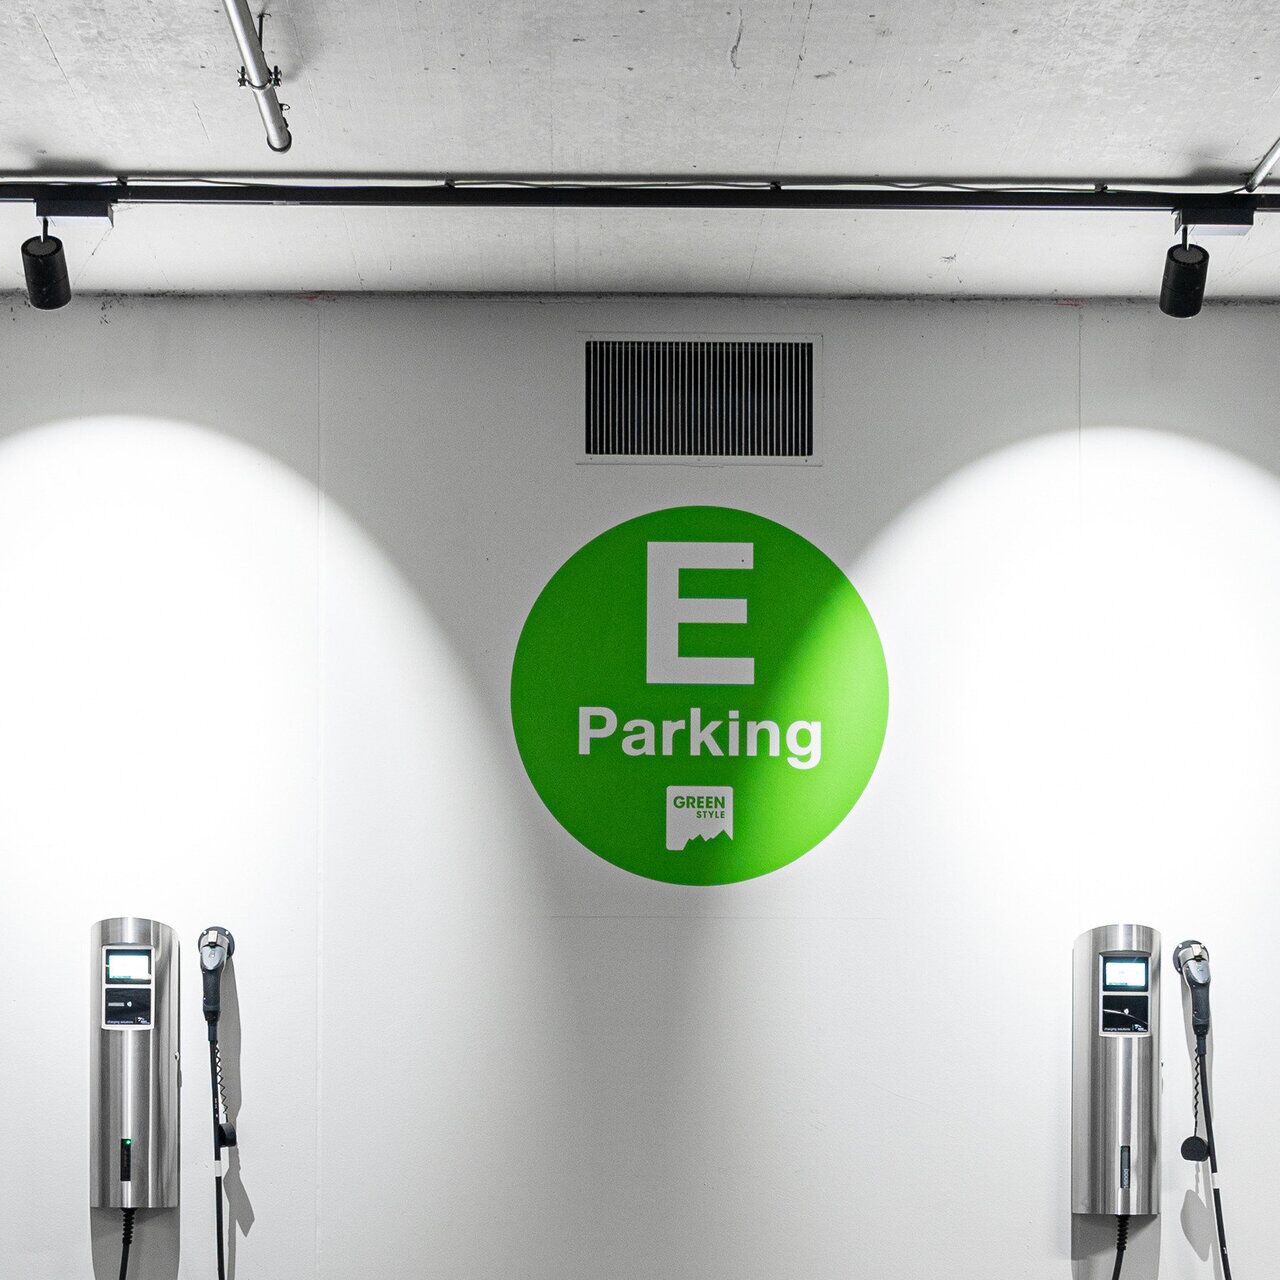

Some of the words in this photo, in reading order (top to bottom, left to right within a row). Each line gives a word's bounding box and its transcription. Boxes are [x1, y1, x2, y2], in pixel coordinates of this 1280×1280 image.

[645, 541, 755, 685] E
[578, 706, 822, 770] Parking
[673, 795, 725, 809] GREEN
[696, 810, 725, 819] STYLE
